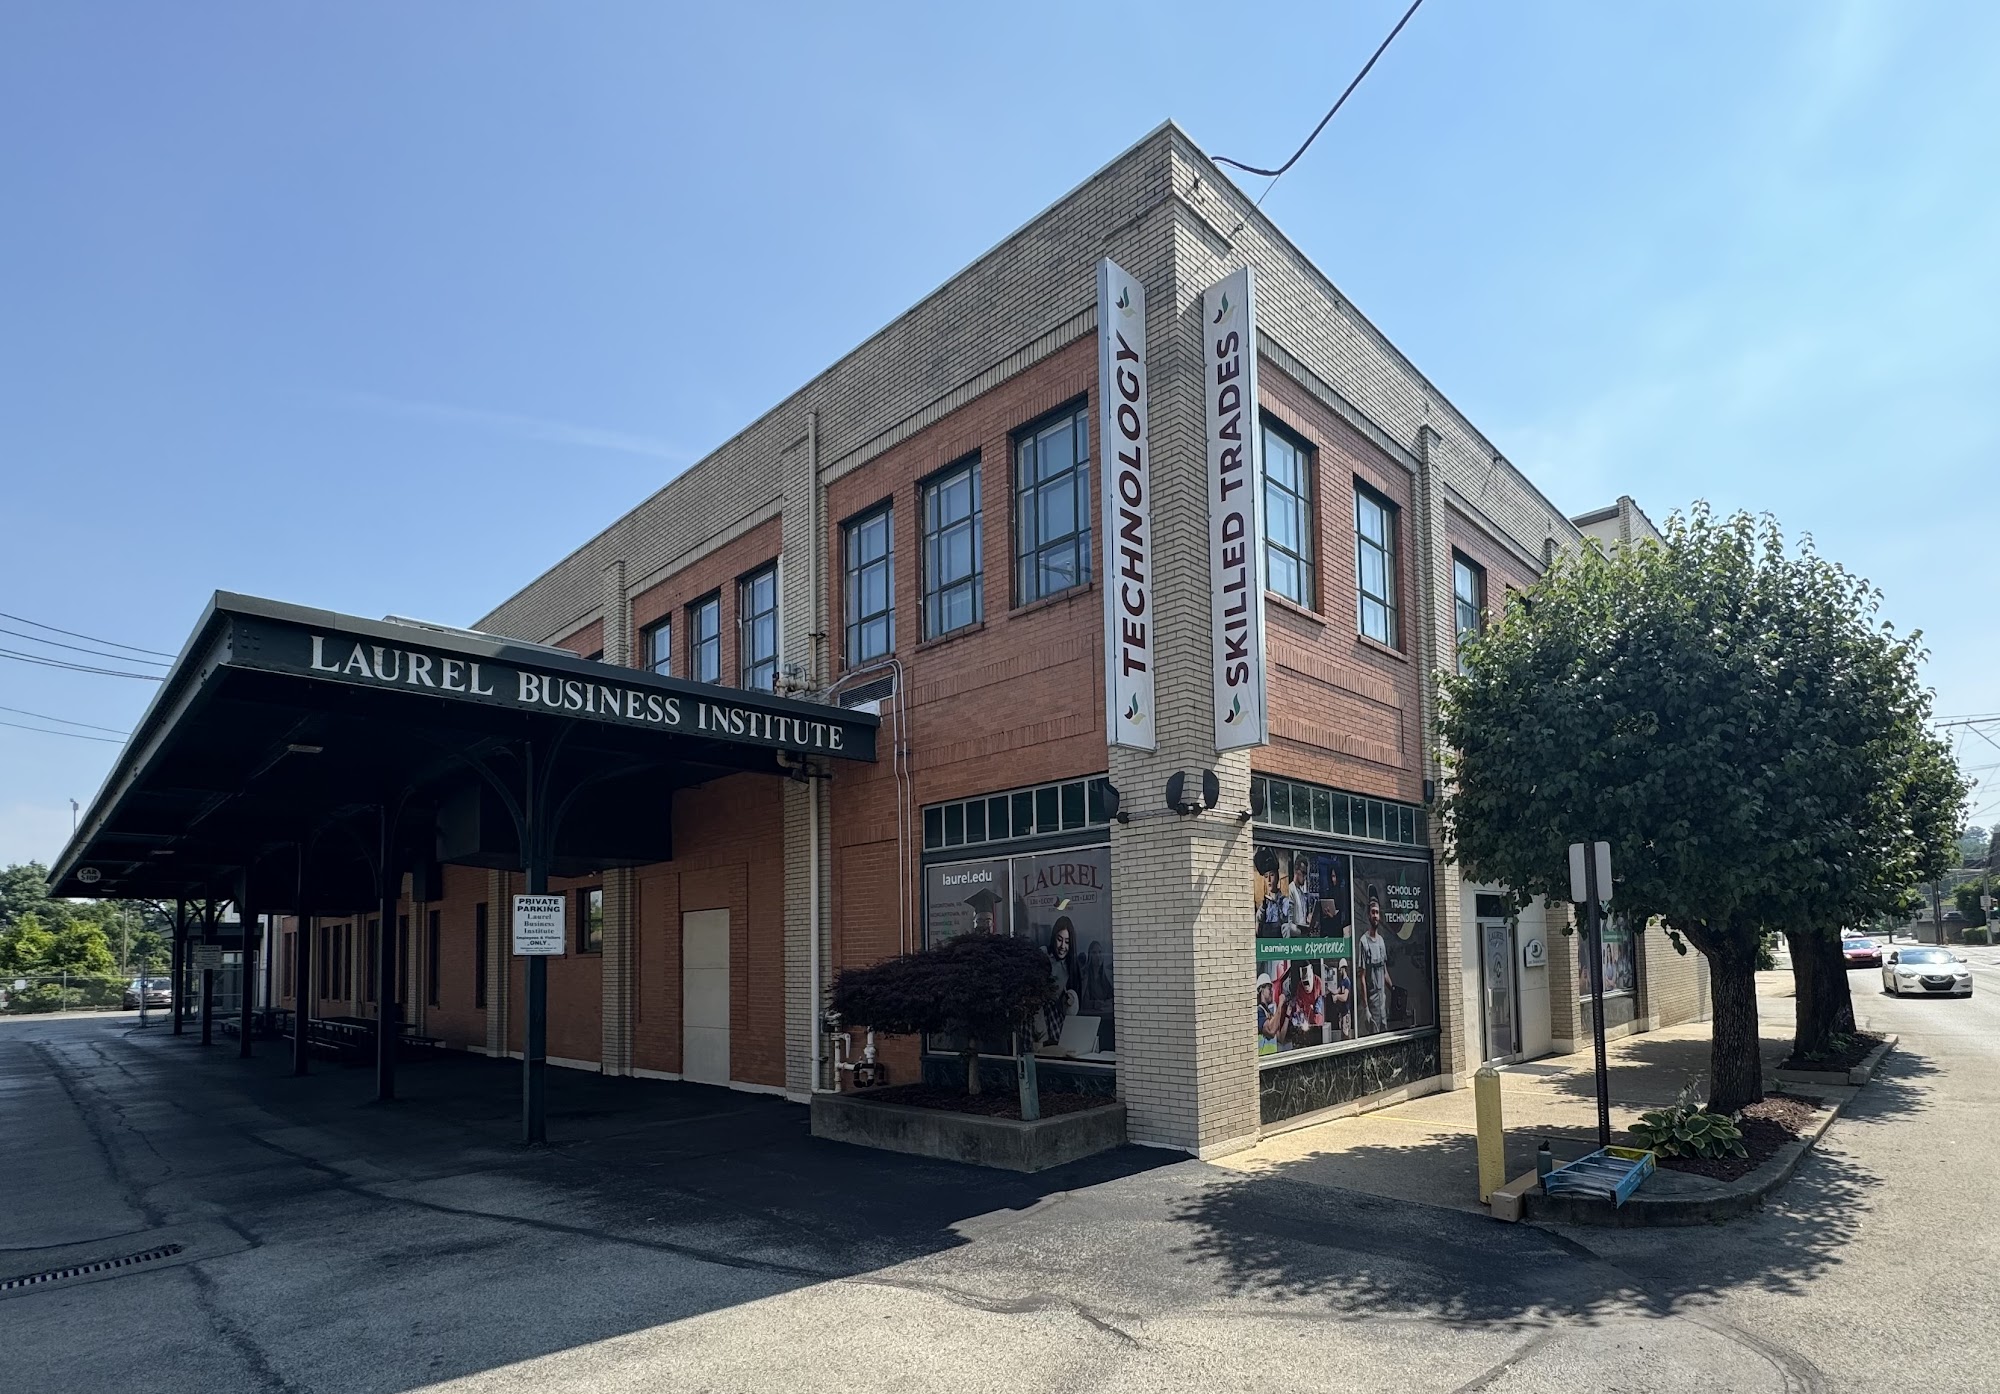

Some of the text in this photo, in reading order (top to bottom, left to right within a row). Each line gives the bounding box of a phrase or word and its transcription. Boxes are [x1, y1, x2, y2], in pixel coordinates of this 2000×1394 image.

[1115, 330, 1146, 677] TECHNOLOGY
[1216, 330, 1249, 687] SKILLED TRADES
[310, 635, 844, 750] LAUREL BUSINESS INSTITUTE
[942, 869, 993, 886] laurel.edu
[1023, 863, 1104, 897] LAUREL
[1387, 884, 1421, 896] SCHOOL OF
[1390, 899, 1419, 909] TRADES &
[1385, 912, 1425, 924] TECHNOLOGY
[1260, 944, 1289, 955] Learning
[1290, 944, 1302, 955] you
